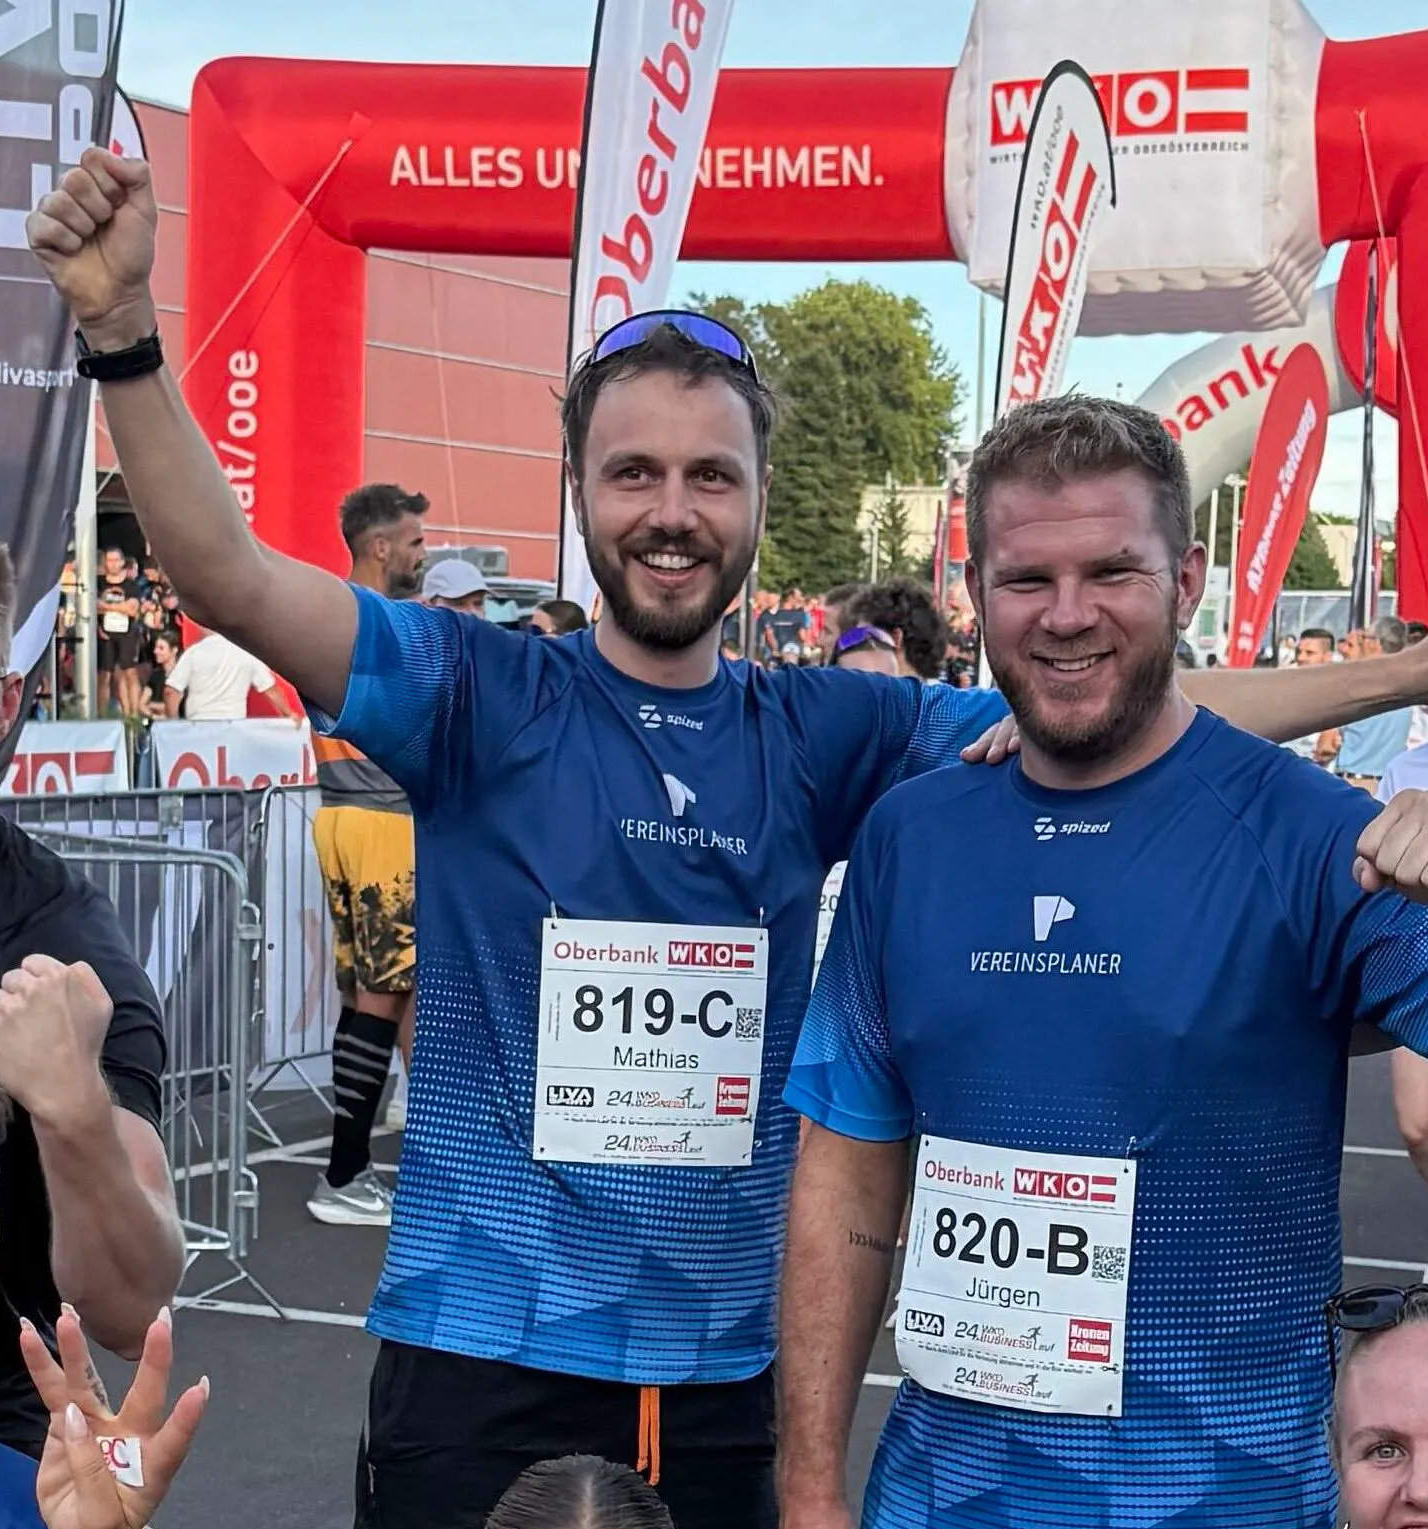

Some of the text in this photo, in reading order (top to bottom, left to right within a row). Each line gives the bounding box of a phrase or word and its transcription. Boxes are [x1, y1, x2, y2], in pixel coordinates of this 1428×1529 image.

[389, 144, 523, 188] ALLES
[1060, 819, 1110, 838] spized
[554, 940, 732, 967] Oberbank WKO
[971, 950, 1122, 976] VEREINSPLANER
[572, 984, 734, 1039] 819-C
[613, 1046, 700, 1069] Mathias
[924, 1160, 1089, 1199] Oberbank WKO
[932, 1206, 1090, 1277] 820-B
[966, 1276, 1041, 1308] Jürgen
